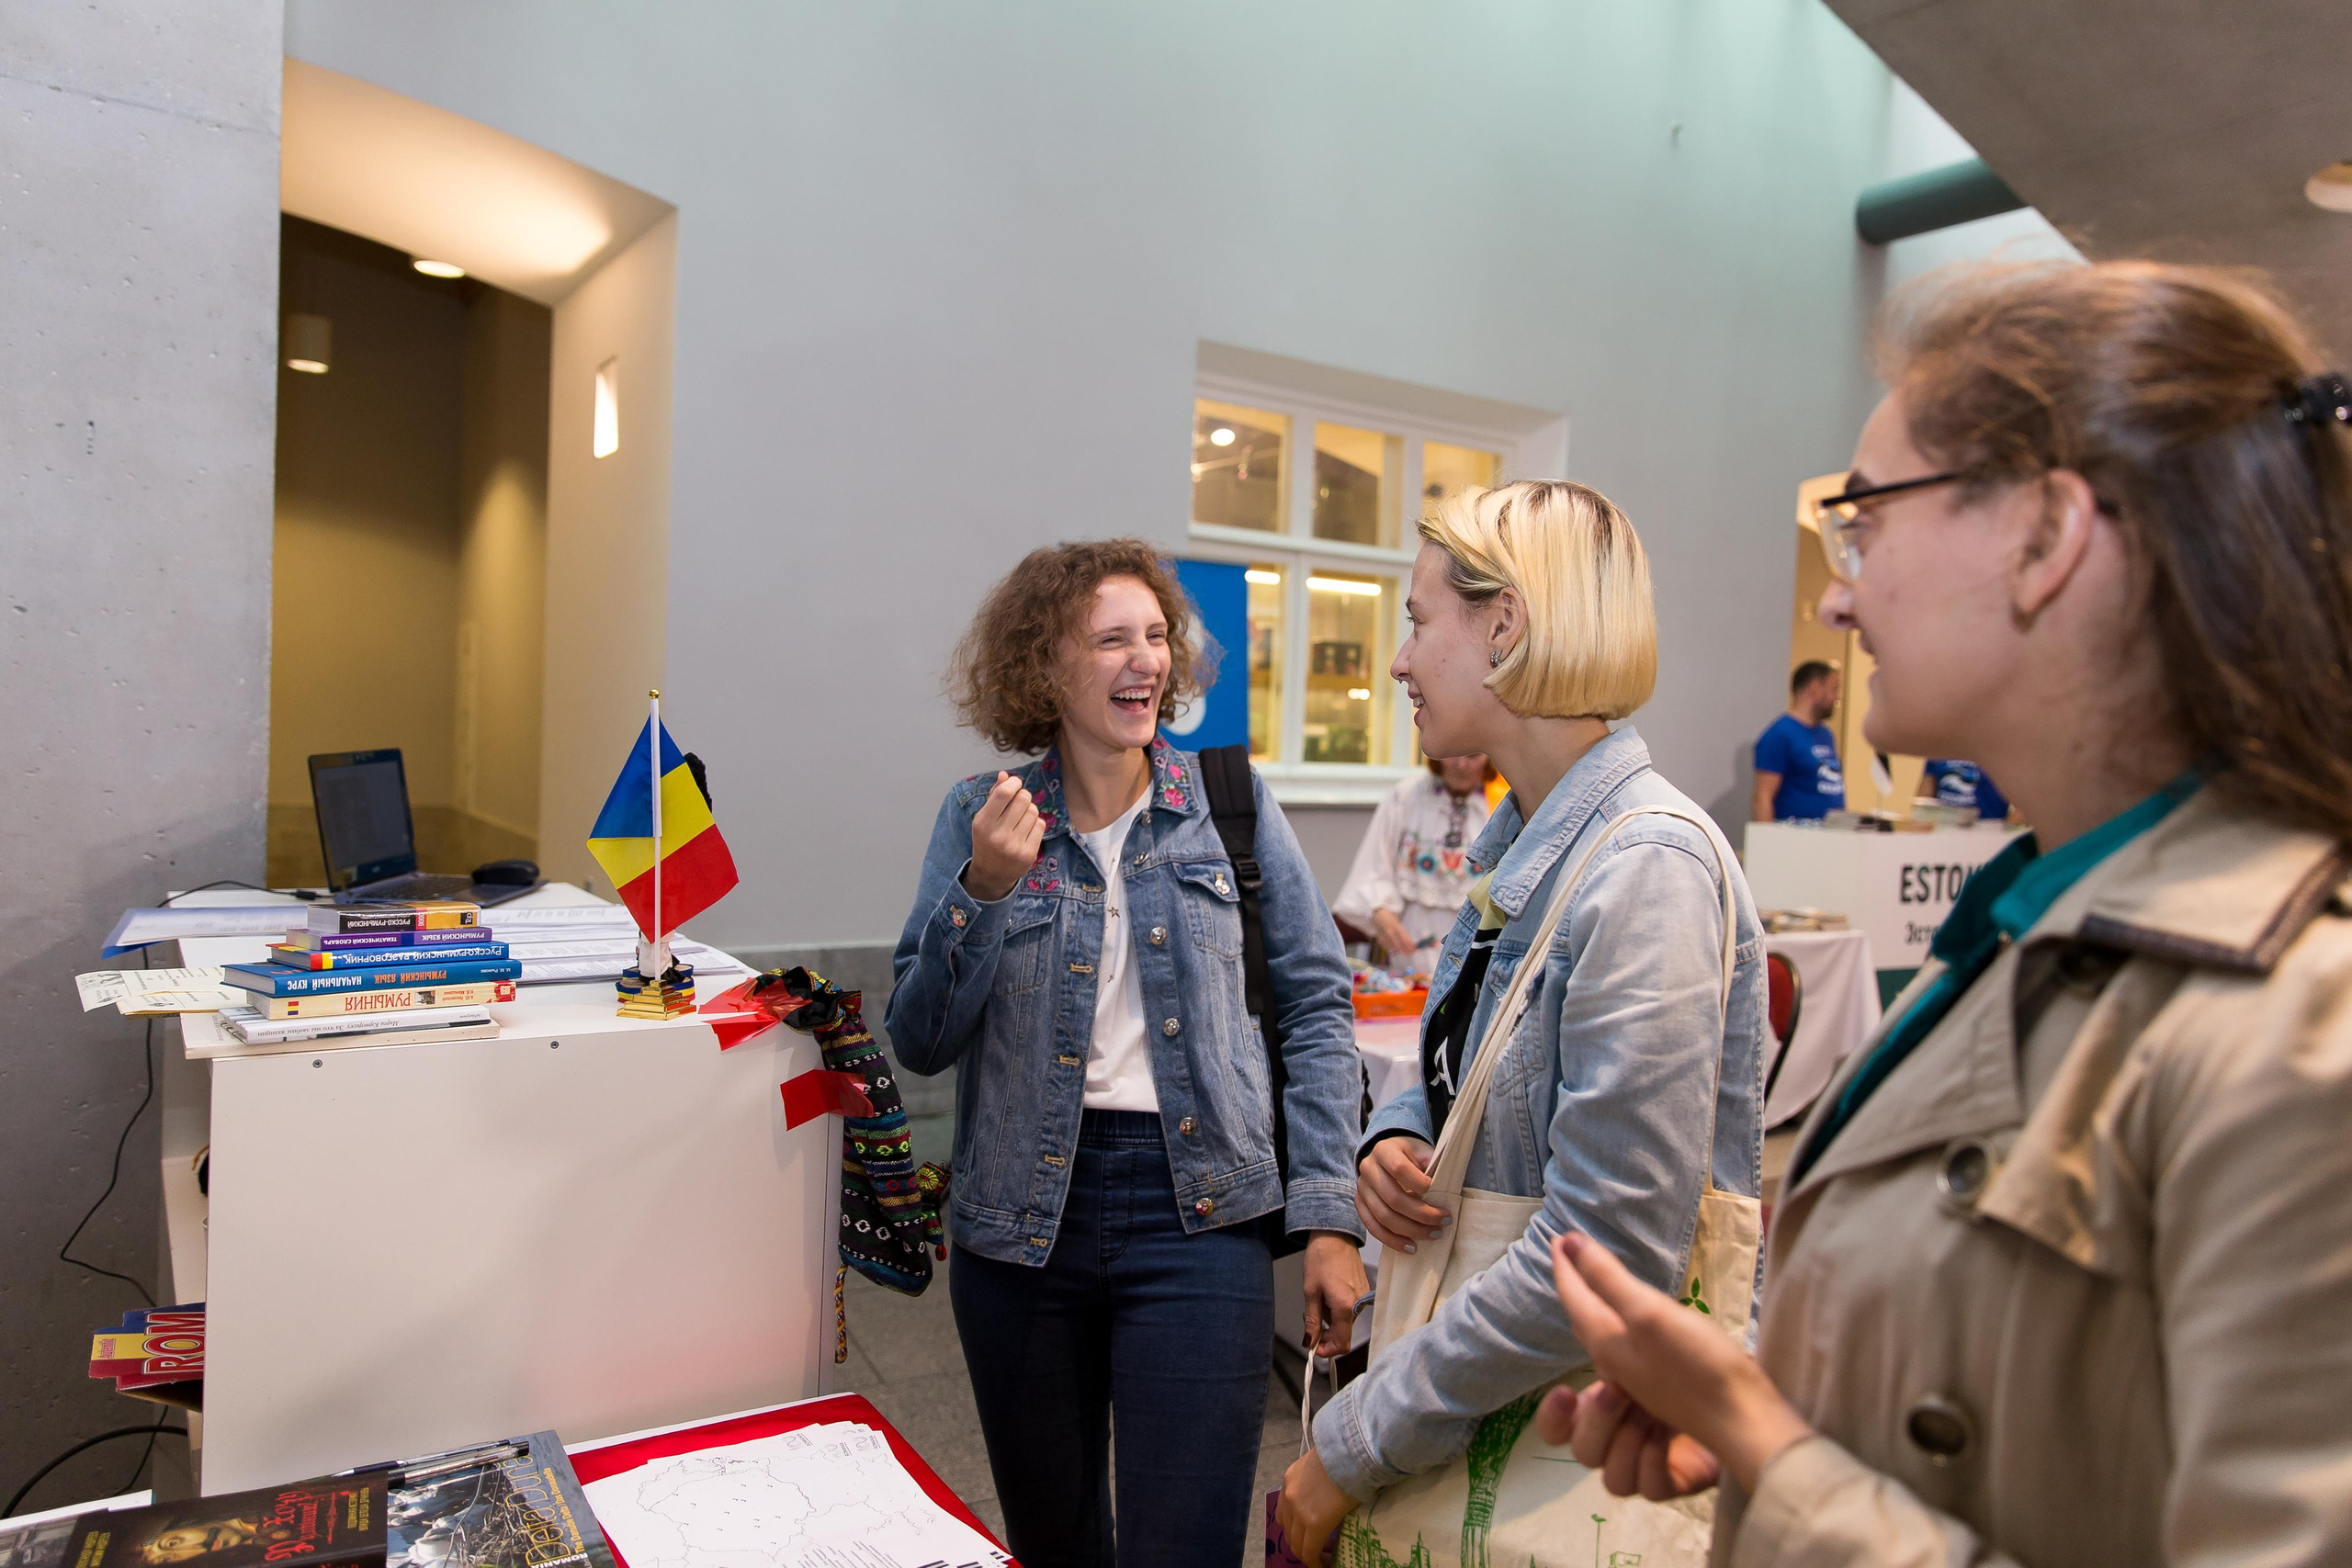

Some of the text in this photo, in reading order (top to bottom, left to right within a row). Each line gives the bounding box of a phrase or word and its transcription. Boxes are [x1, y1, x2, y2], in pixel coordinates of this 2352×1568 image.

[347, 919, 411, 929] РУССКО-РУМЫНСКИЙ
[345, 953, 410, 964] РАЗГОВОРНИК
[288, 976, 362, 991] НАЧАЛЬНЫЙ КУРС
[374, 970, 447, 985] РУМЫНСКИЙ ЯЗЫК
[345, 993, 412, 1011] РУМЫНИЯ
[142, 1312, 205, 1374] ROM
[543, 1467, 560, 1494] Donaudelta
[554, 1495, 564, 1504] Das
[559, 1506, 571, 1518] Delta
[516, 1507, 571, 1565] Delta
[566, 1519, 581, 1540] Danube
[574, 1541, 585, 1553] The
